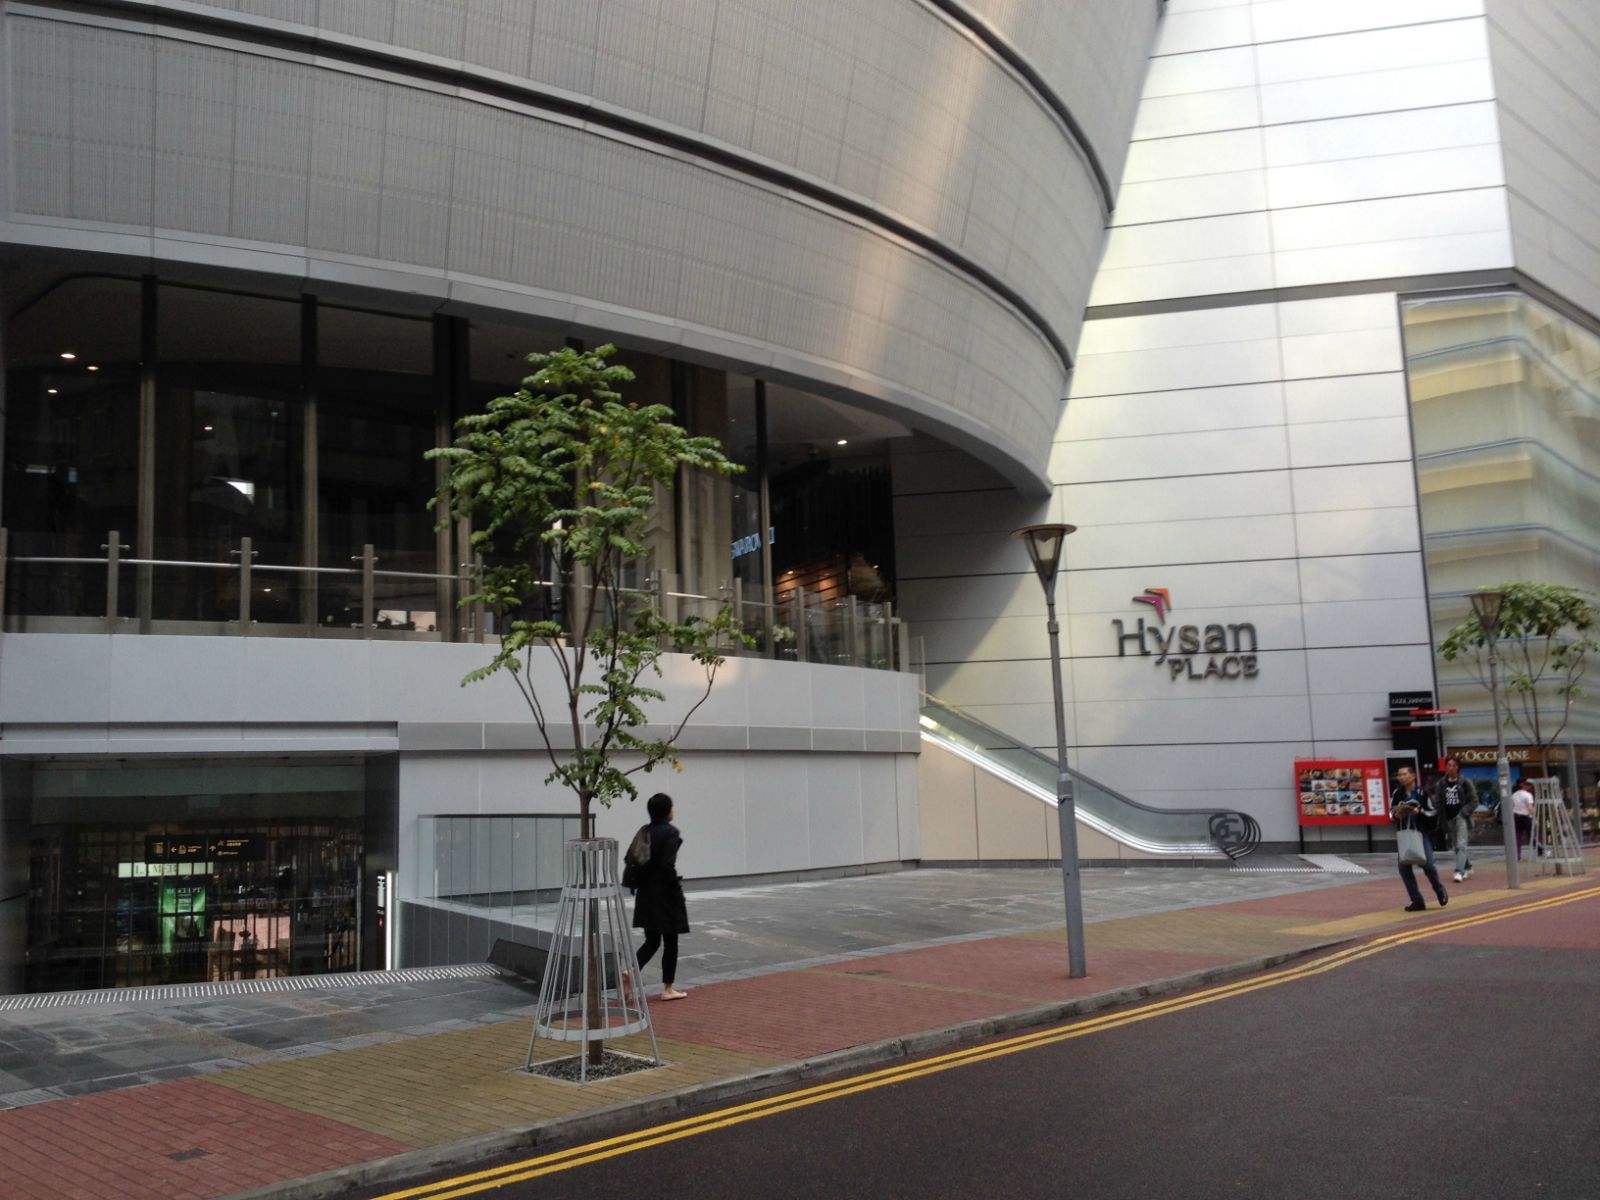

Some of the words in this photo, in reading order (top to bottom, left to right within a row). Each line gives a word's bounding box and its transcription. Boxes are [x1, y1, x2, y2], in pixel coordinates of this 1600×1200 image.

[1112, 618, 1259, 665] Hysan
[1168, 654, 1260, 681] PLACE
[1461, 750, 1530, 762] L'OCCIANE
